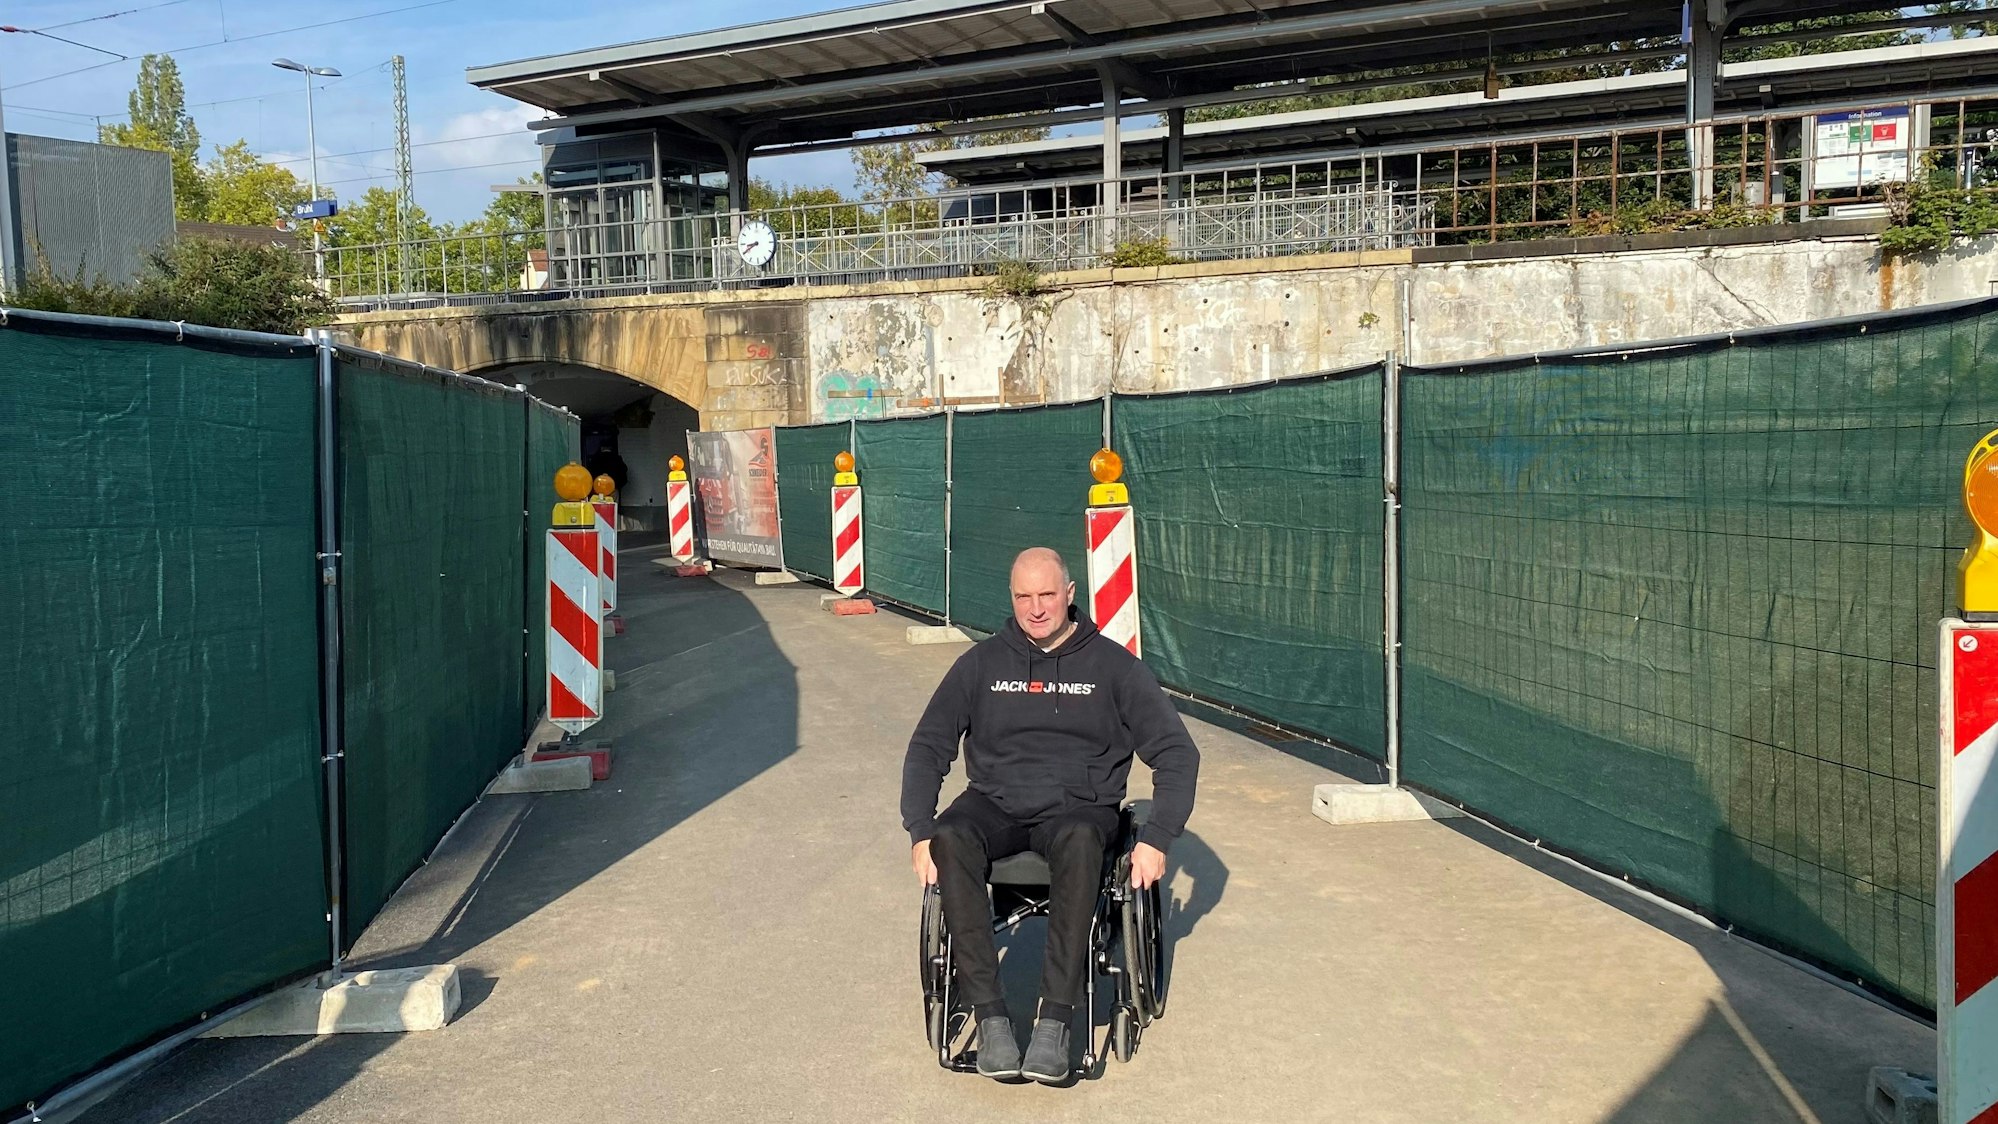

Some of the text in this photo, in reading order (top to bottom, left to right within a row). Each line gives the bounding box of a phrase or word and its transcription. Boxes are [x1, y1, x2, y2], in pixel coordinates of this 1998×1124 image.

[1848, 111, 1882, 119] Information
[727, 539, 736, 552] FÜR
[990, 680, 1092, 695] JACK JONES
